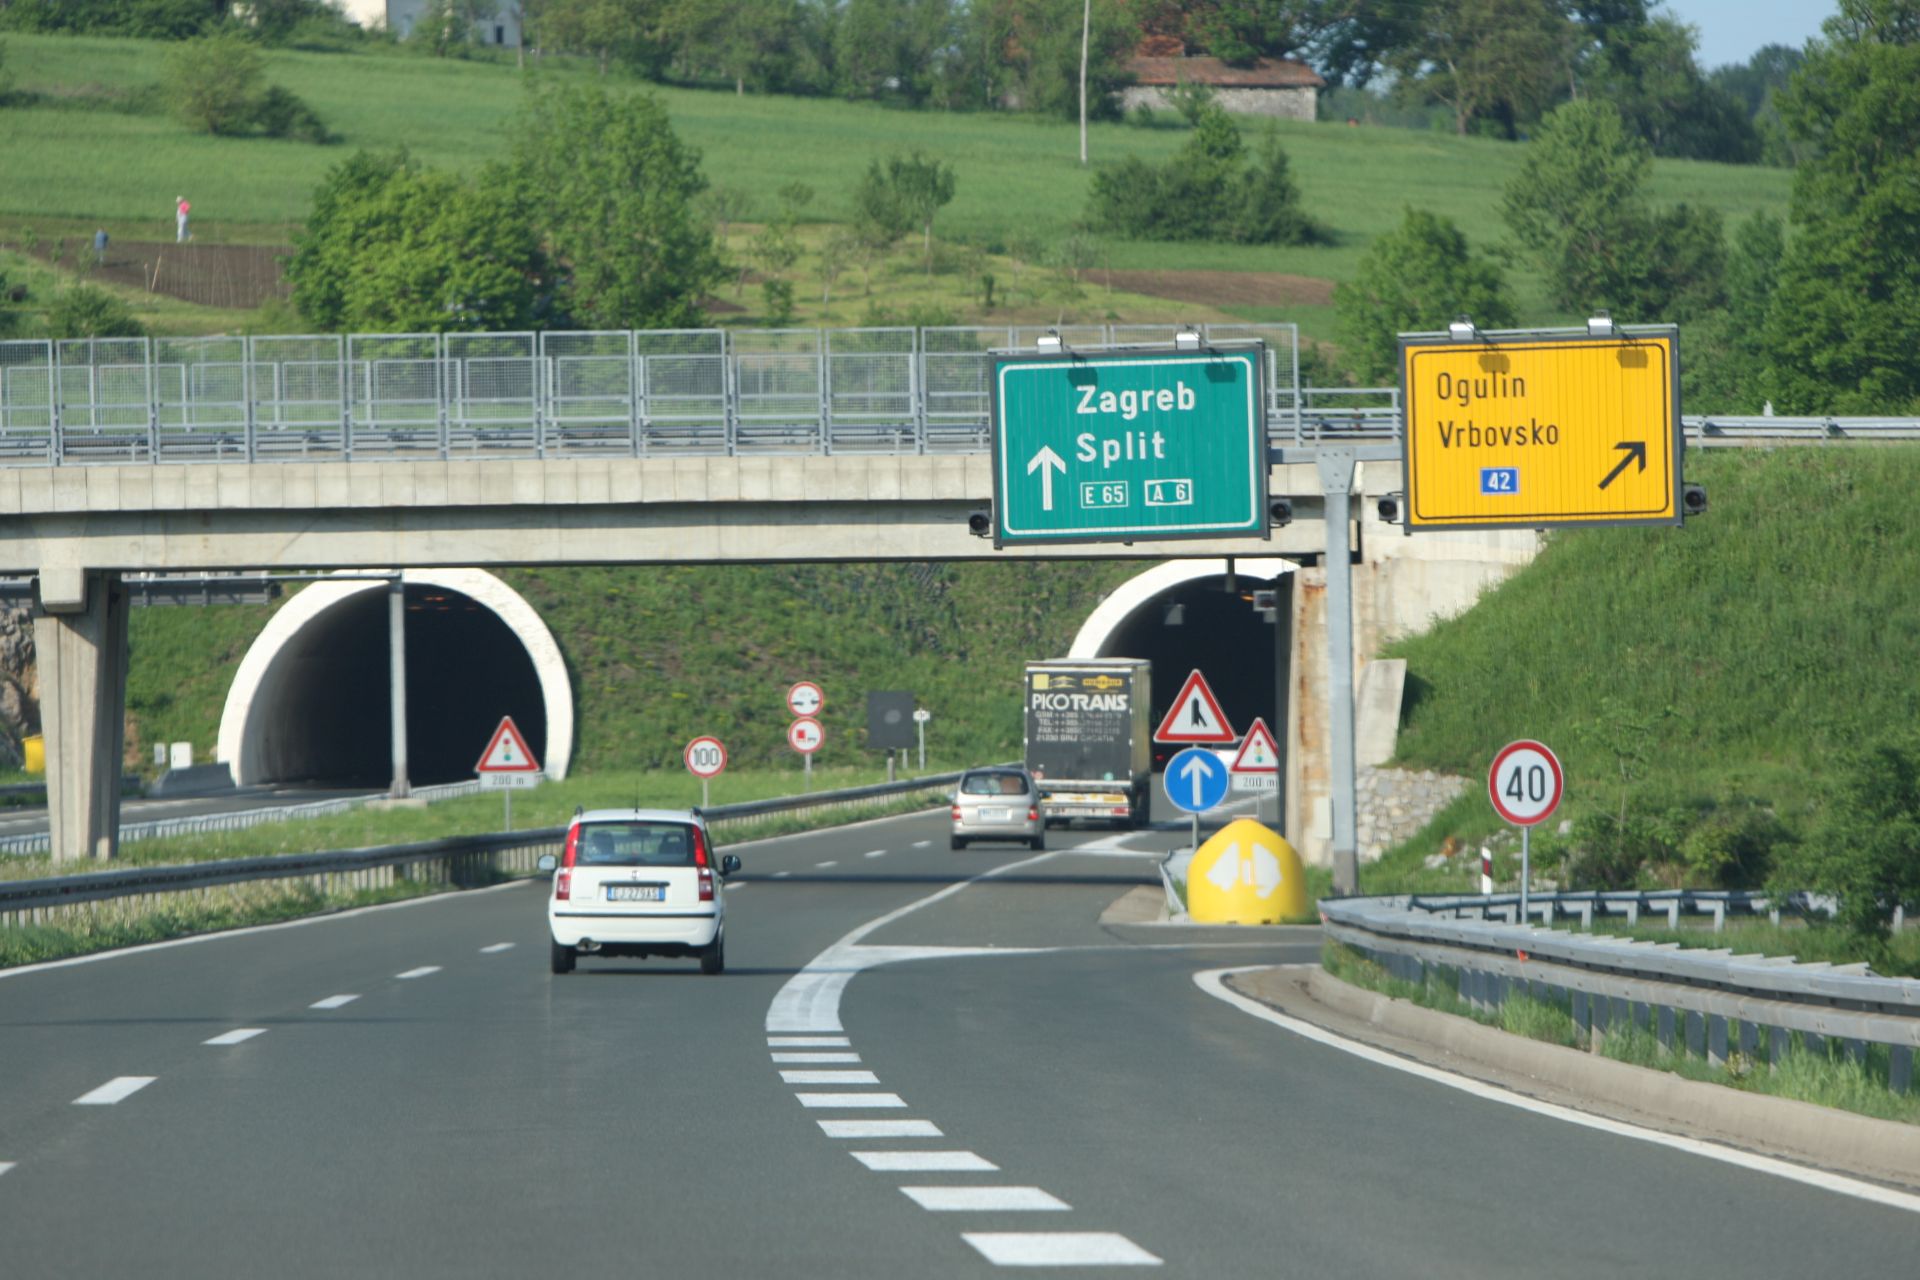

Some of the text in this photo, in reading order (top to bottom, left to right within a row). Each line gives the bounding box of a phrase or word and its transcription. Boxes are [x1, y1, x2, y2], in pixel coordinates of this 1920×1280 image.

[1437, 370, 1525, 407] Ogulin
[1076, 381, 1195, 420] Zagreb
[1438, 417, 1559, 448] Vrbovsko
[1076, 431, 1165, 468] Split
[1488, 472, 1511, 490] 42
[1085, 485, 1124, 504] E 65
[1153, 484, 1186, 501] A 6
[694, 748, 720, 766] 100
[492, 774, 511, 785] 200
[1243, 776, 1262, 787] 200
[1506, 765, 1546, 802] 40
